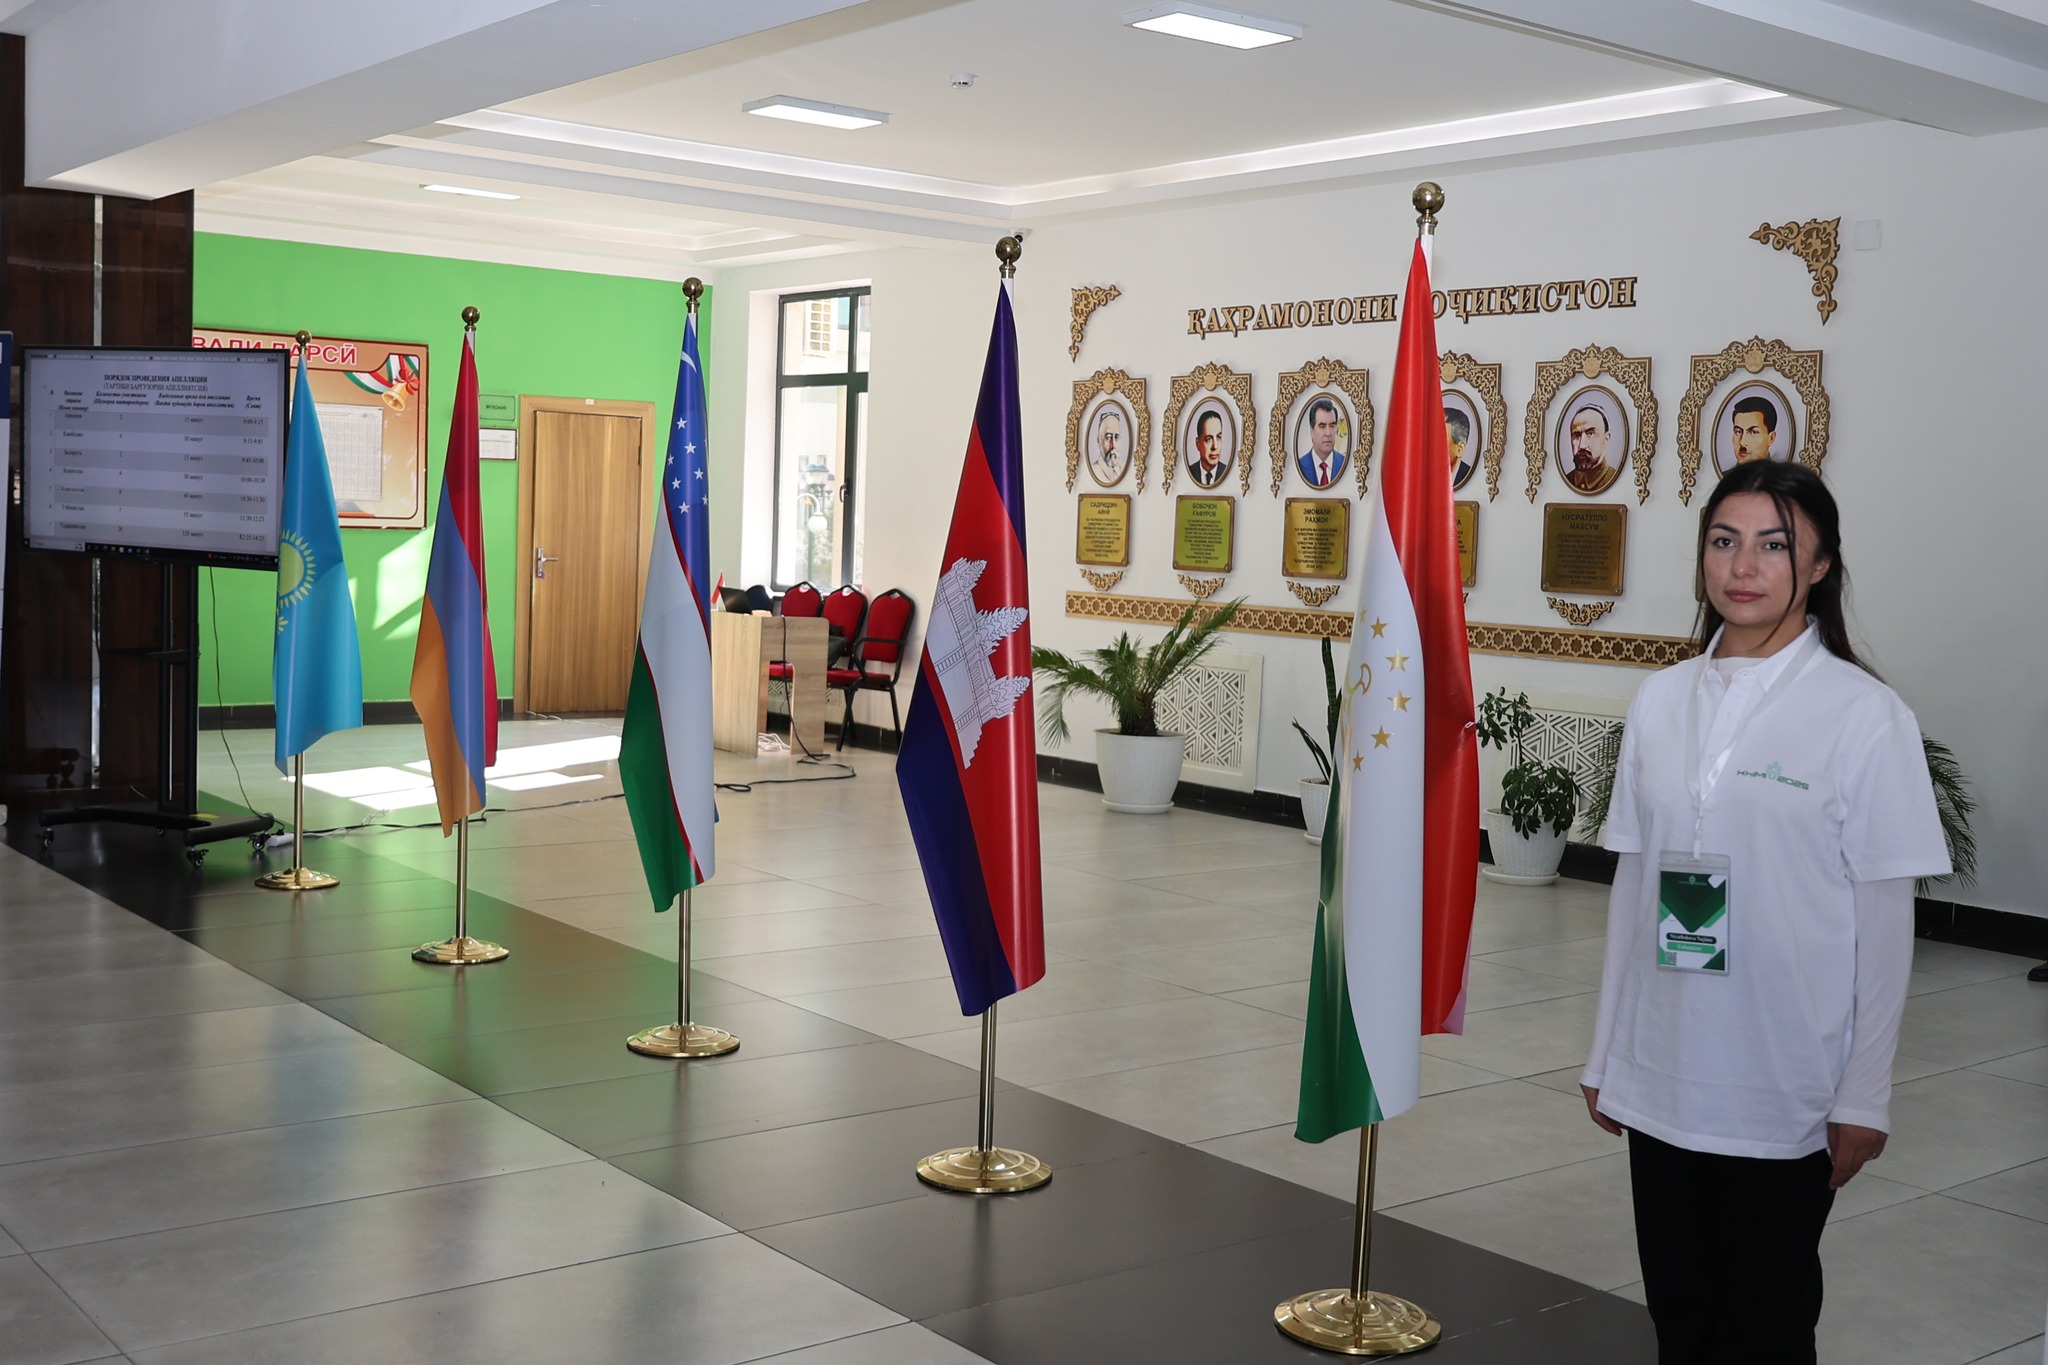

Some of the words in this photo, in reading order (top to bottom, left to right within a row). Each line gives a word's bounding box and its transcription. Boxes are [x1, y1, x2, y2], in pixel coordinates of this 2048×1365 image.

[1187, 294, 1398, 340] ҚАҲРАМОНОНИ
[1430, 277, 1637, 324] ОҶИКИСТОН
[1561, 513, 1608, 522] НУСРАТУЛЛО
